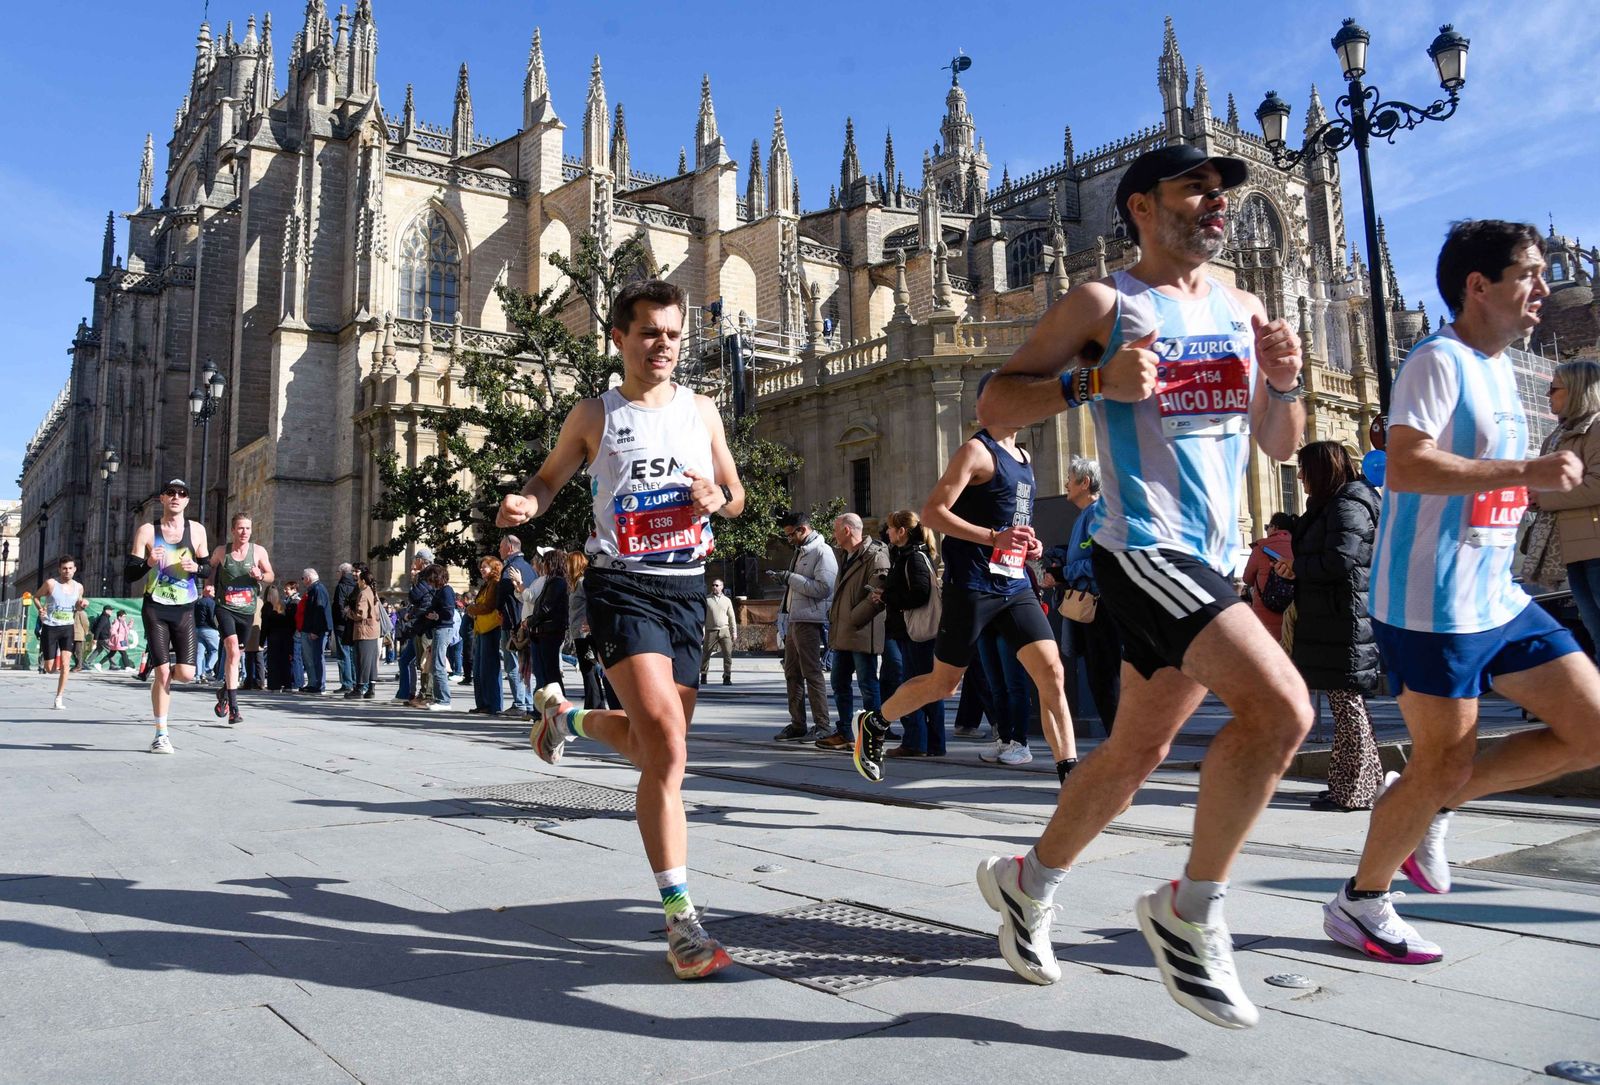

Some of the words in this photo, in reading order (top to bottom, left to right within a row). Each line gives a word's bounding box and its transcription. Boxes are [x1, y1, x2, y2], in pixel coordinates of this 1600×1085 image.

[1188, 340, 1243, 355] ZURICH
[1193, 370, 1222, 384] 1154
[1160, 389, 1209, 412] NICO
[631, 481, 661, 492] BELLEY
[644, 491, 690, 507] ZURICH
[648, 516, 673, 529] 1336
[628, 528, 697, 553] BASTIEN
